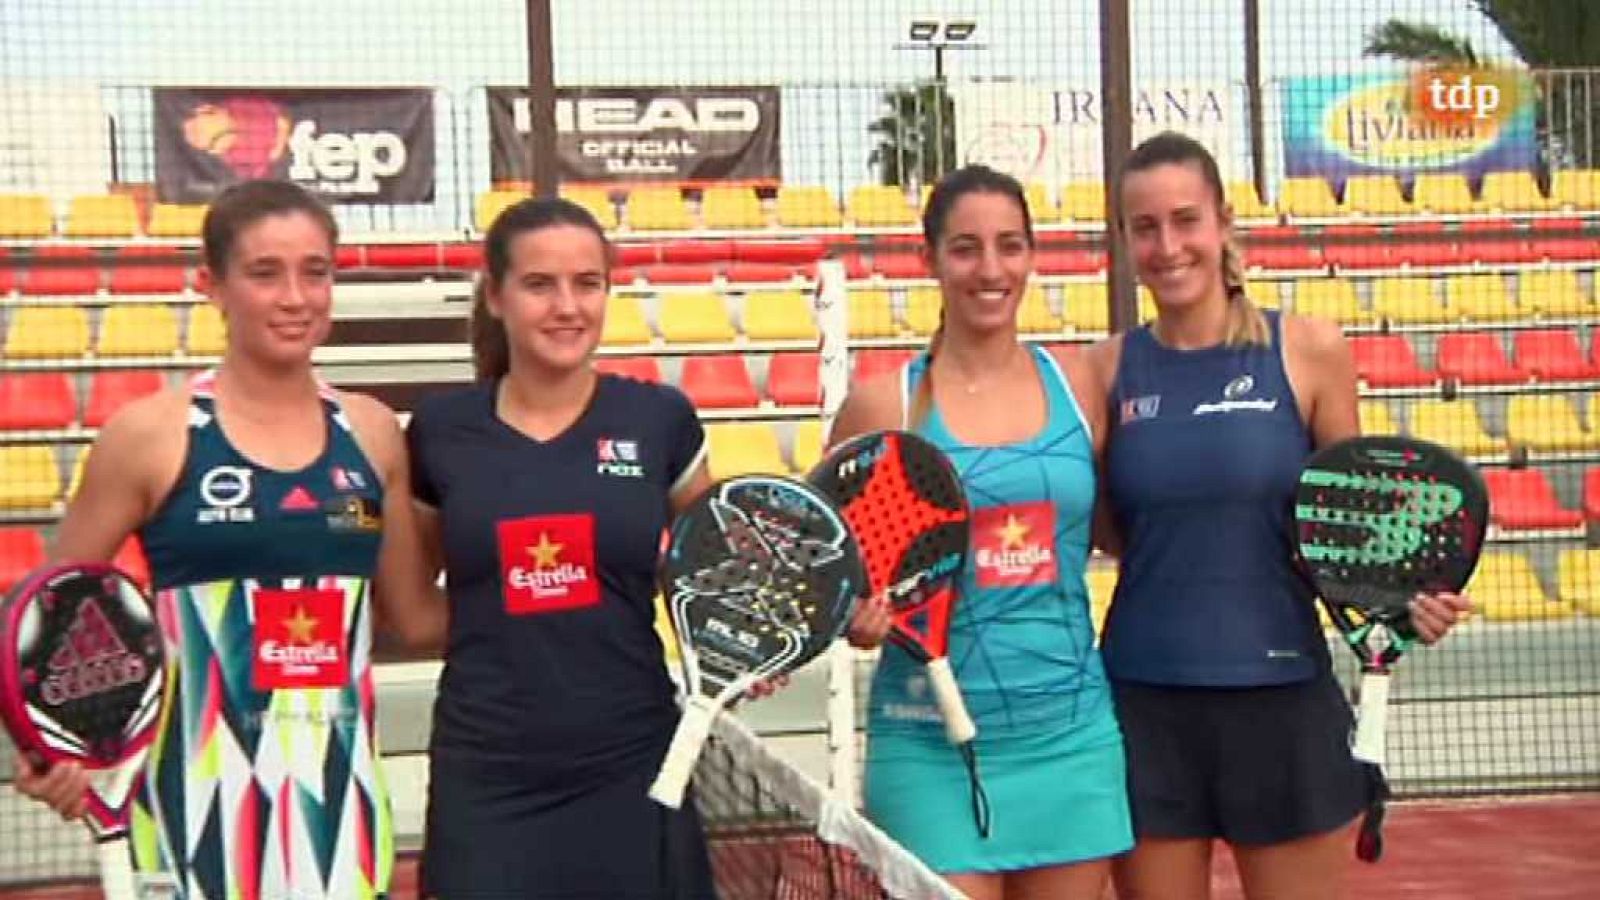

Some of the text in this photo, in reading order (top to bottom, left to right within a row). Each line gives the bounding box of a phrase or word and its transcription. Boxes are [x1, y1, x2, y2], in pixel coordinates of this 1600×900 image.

[513, 97, 760, 132] HEAD
[1053, 90, 1222, 123] IRANA
[289, 119, 407, 184] fep
[582, 138, 698, 156] OFFICIAL
[605, 157, 677, 174] BALL
[508, 563, 588, 590] Estrella
[260, 639, 339, 664] Estrella
